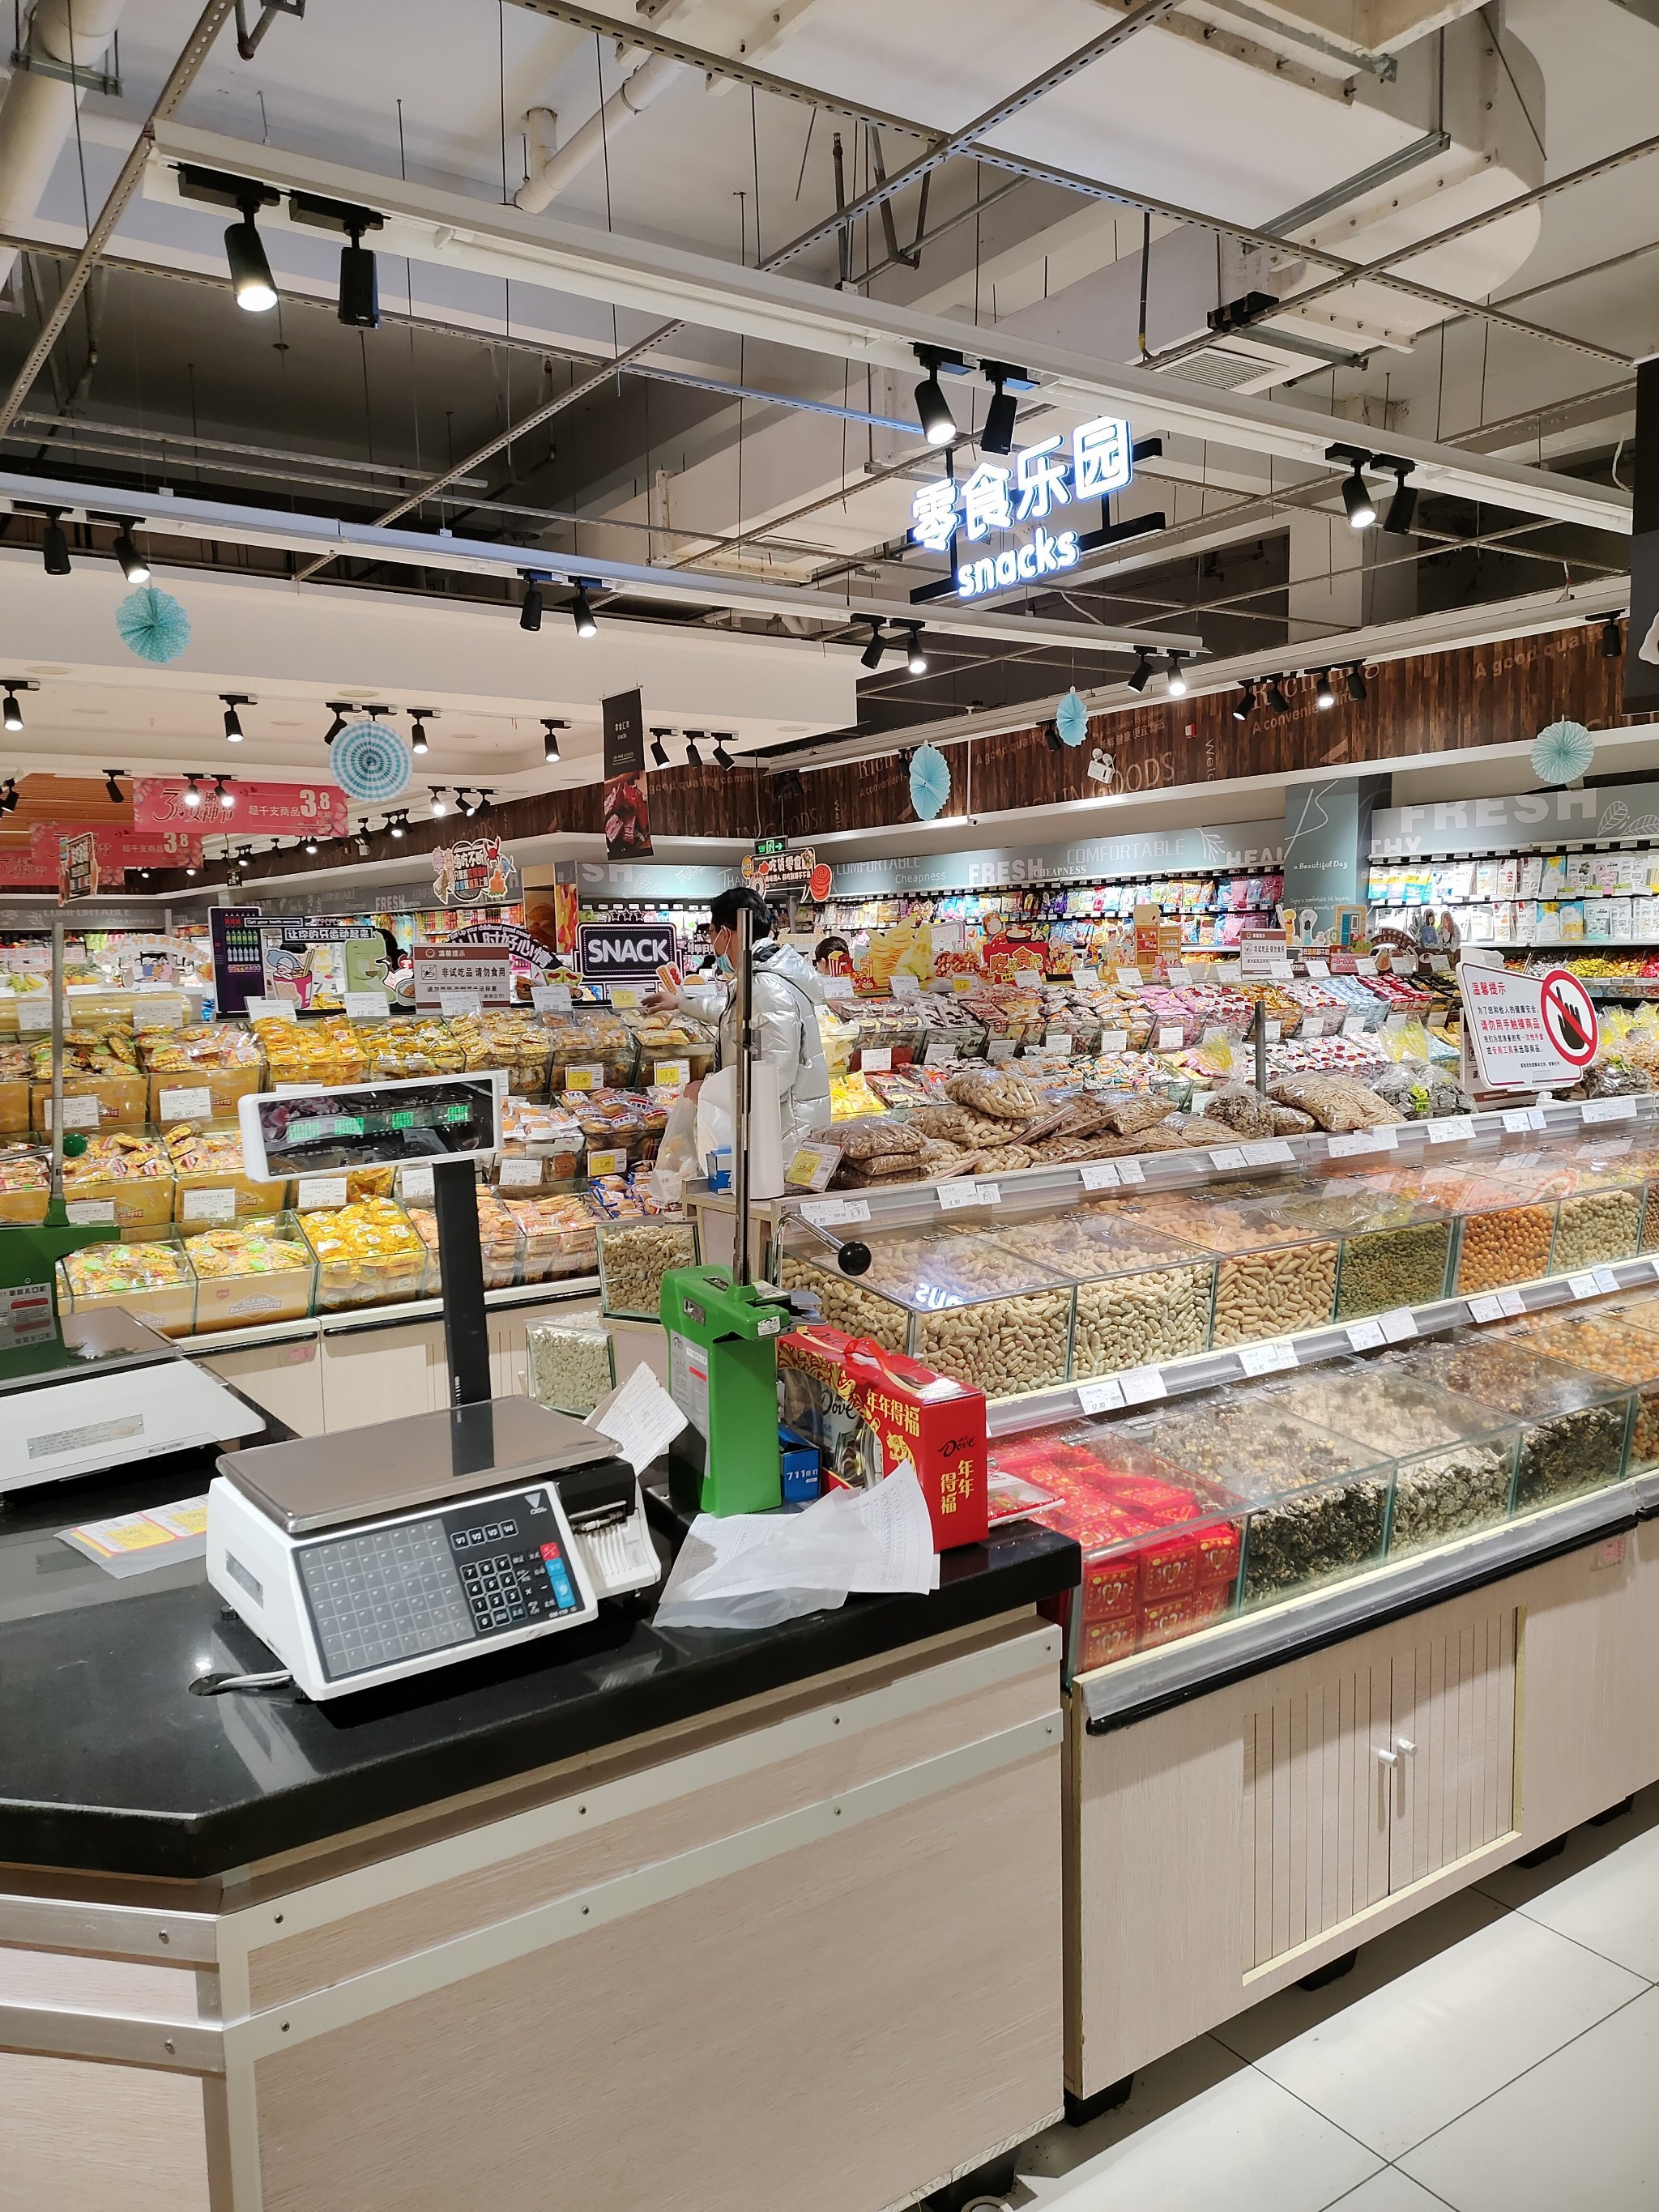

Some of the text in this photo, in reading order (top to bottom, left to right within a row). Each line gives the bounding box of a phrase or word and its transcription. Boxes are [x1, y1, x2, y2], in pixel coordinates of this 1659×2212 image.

[912, 416, 1132, 551] 零食乐园
[958, 526, 1080, 597] snacks
[1475, 662, 1486, 680] A
[1252, 721, 1262, 735] A
[299, 789, 331, 818] 3.8
[164, 832, 189, 854] 3.8
[1066, 838, 1187, 865] COMFORTABLE
[967, 858, 1044, 885] FRESH
[1299, 859, 1333, 871] Beautiful
[1333, 859, 1349, 870] Day
[895, 870, 946, 884] Cheapness
[375, 894, 406, 912] FRESH
[288, 929, 373, 940] 让你的牙齿动起来
[466, 926, 478, 936] your
[502, 926, 516, 934] good
[516, 929, 532, 940] mood
[588, 939, 670, 964] SNACK
[441, 967, 506, 978] 非试吃品 请勿食用
[1472, 982, 1507, 995] 温馨提示
[172, 1110, 194, 1119] 29.90
[308, 1199, 330, 1207] 15.50
[194, 1210, 218, 1218] 29.90
[866, 1388, 921, 1438] 年年得福
[937, 1436, 976, 1457] Dove
[957, 1460, 974, 1500] 年年
[940, 1472, 957, 1515] 得福
[455, 1524, 514, 1545] V1 V2 V3 V4
